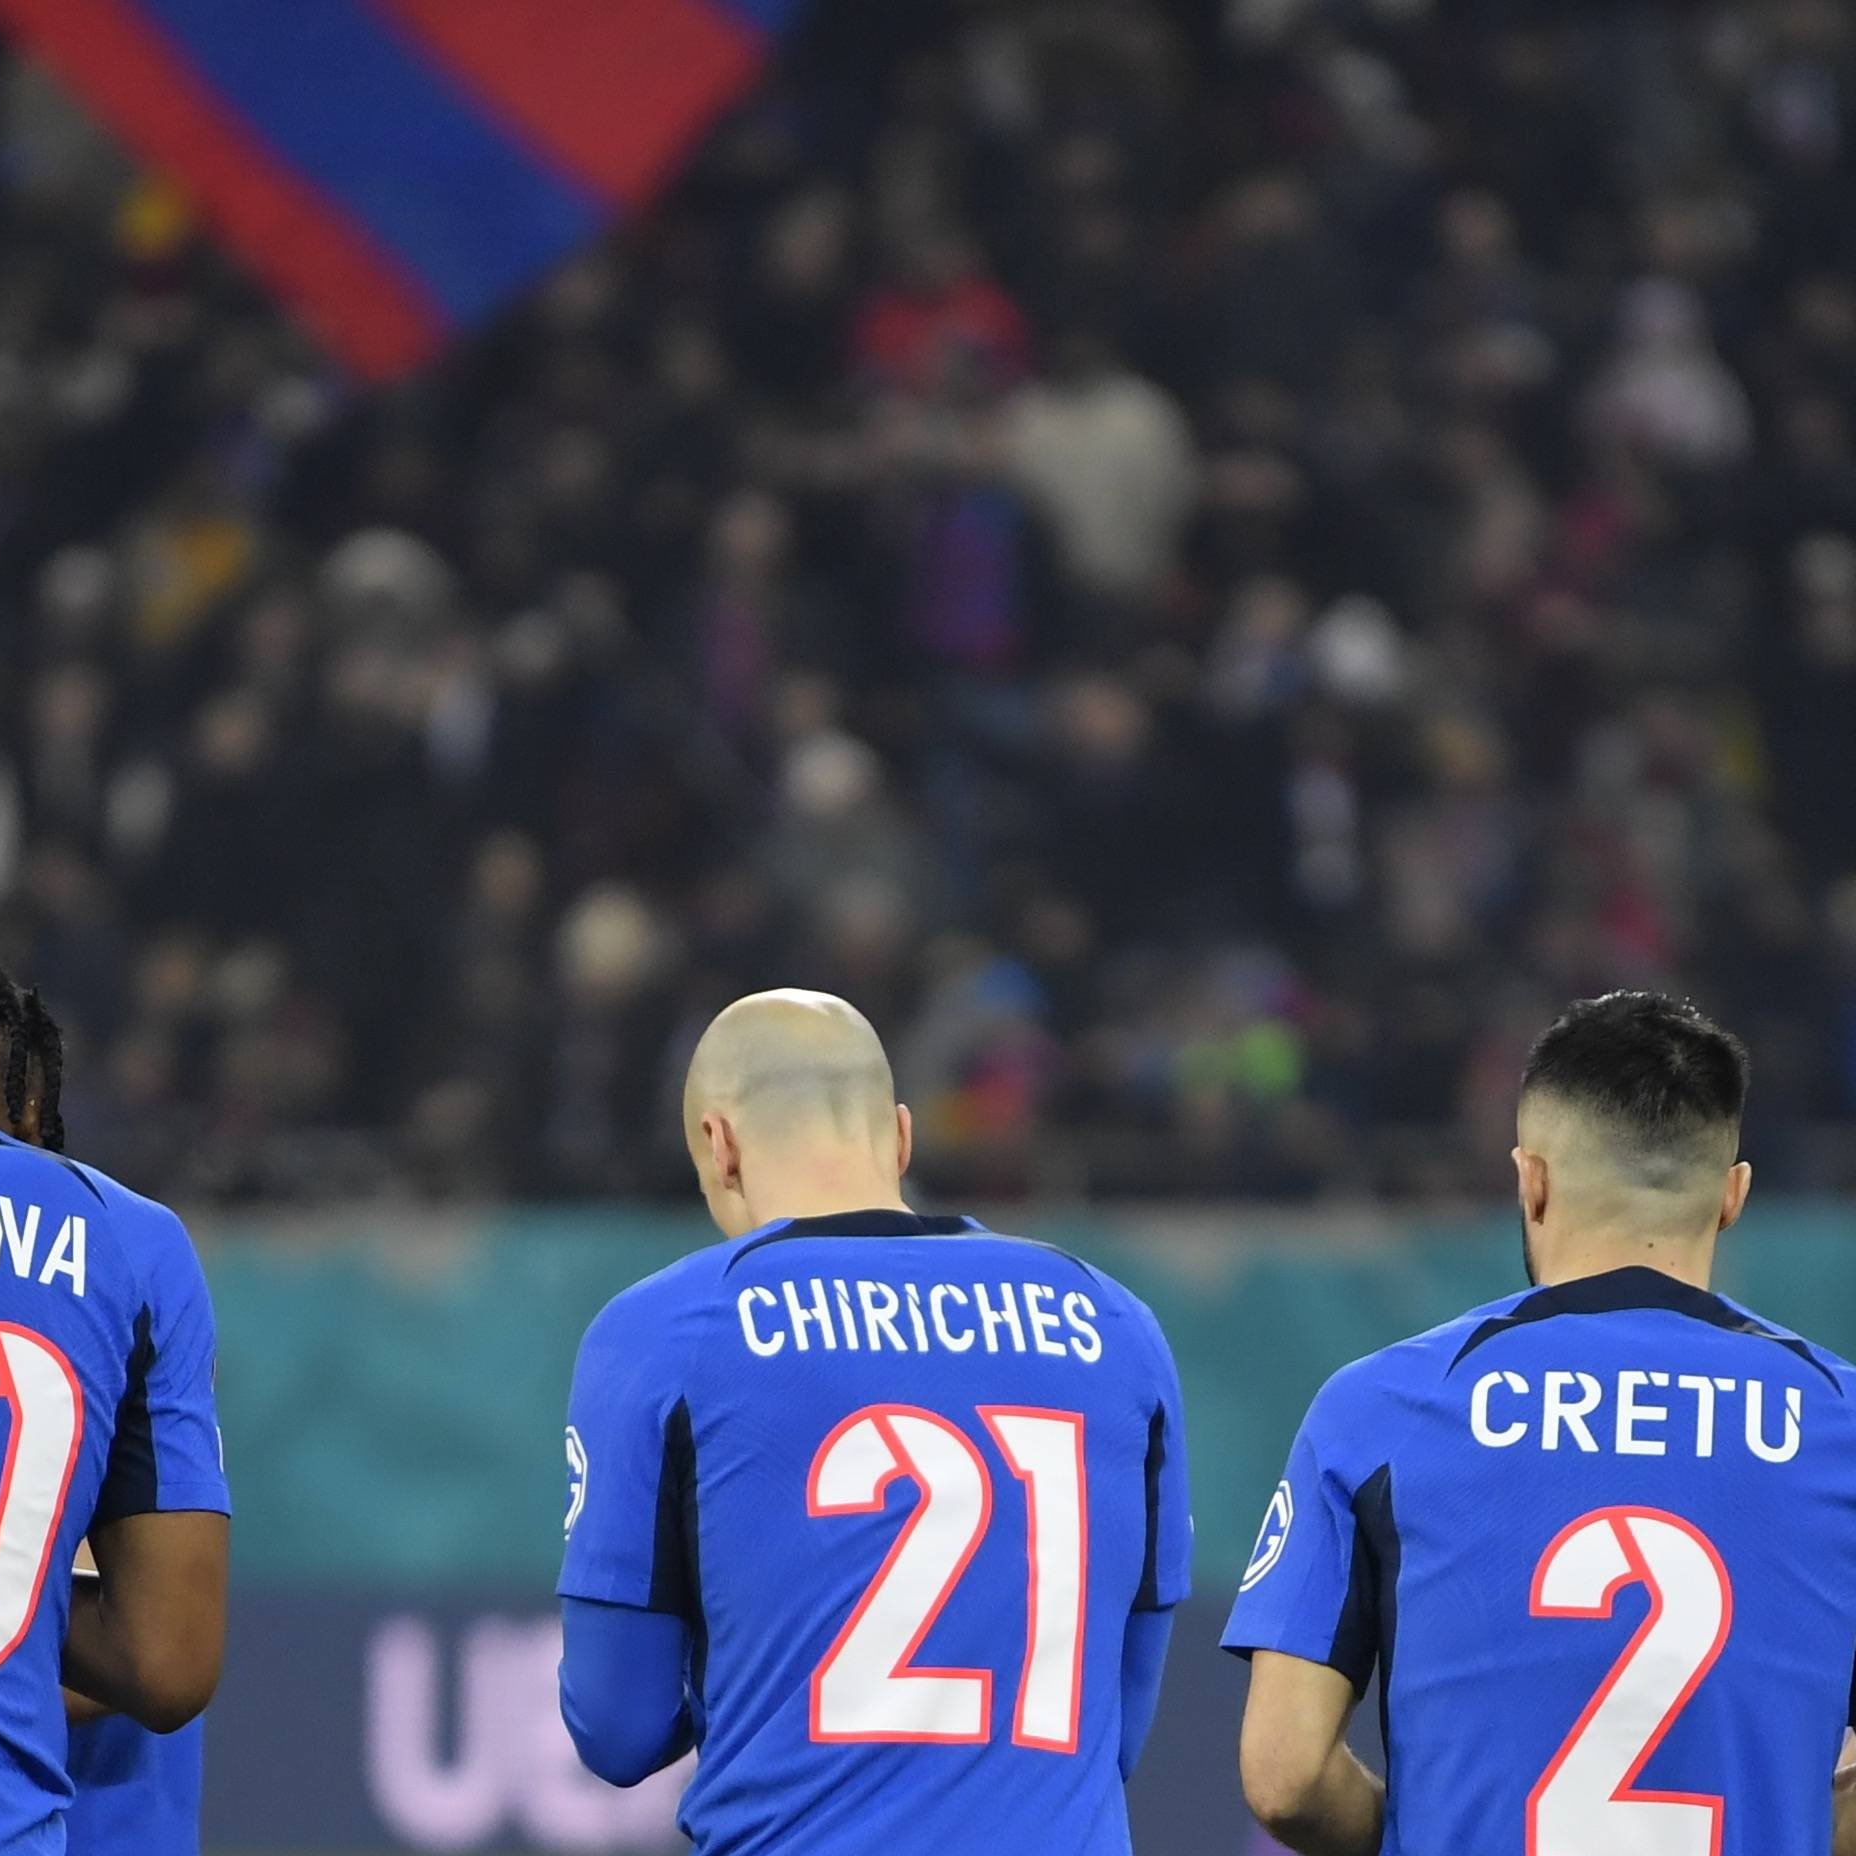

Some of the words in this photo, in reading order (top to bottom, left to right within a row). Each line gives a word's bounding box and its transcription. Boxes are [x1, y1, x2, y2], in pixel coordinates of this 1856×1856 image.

[737, 1278, 1102, 1363] CHIRICHES
[1470, 1370, 1801, 1463] CRETU
[806, 1402, 1088, 1754] 21
